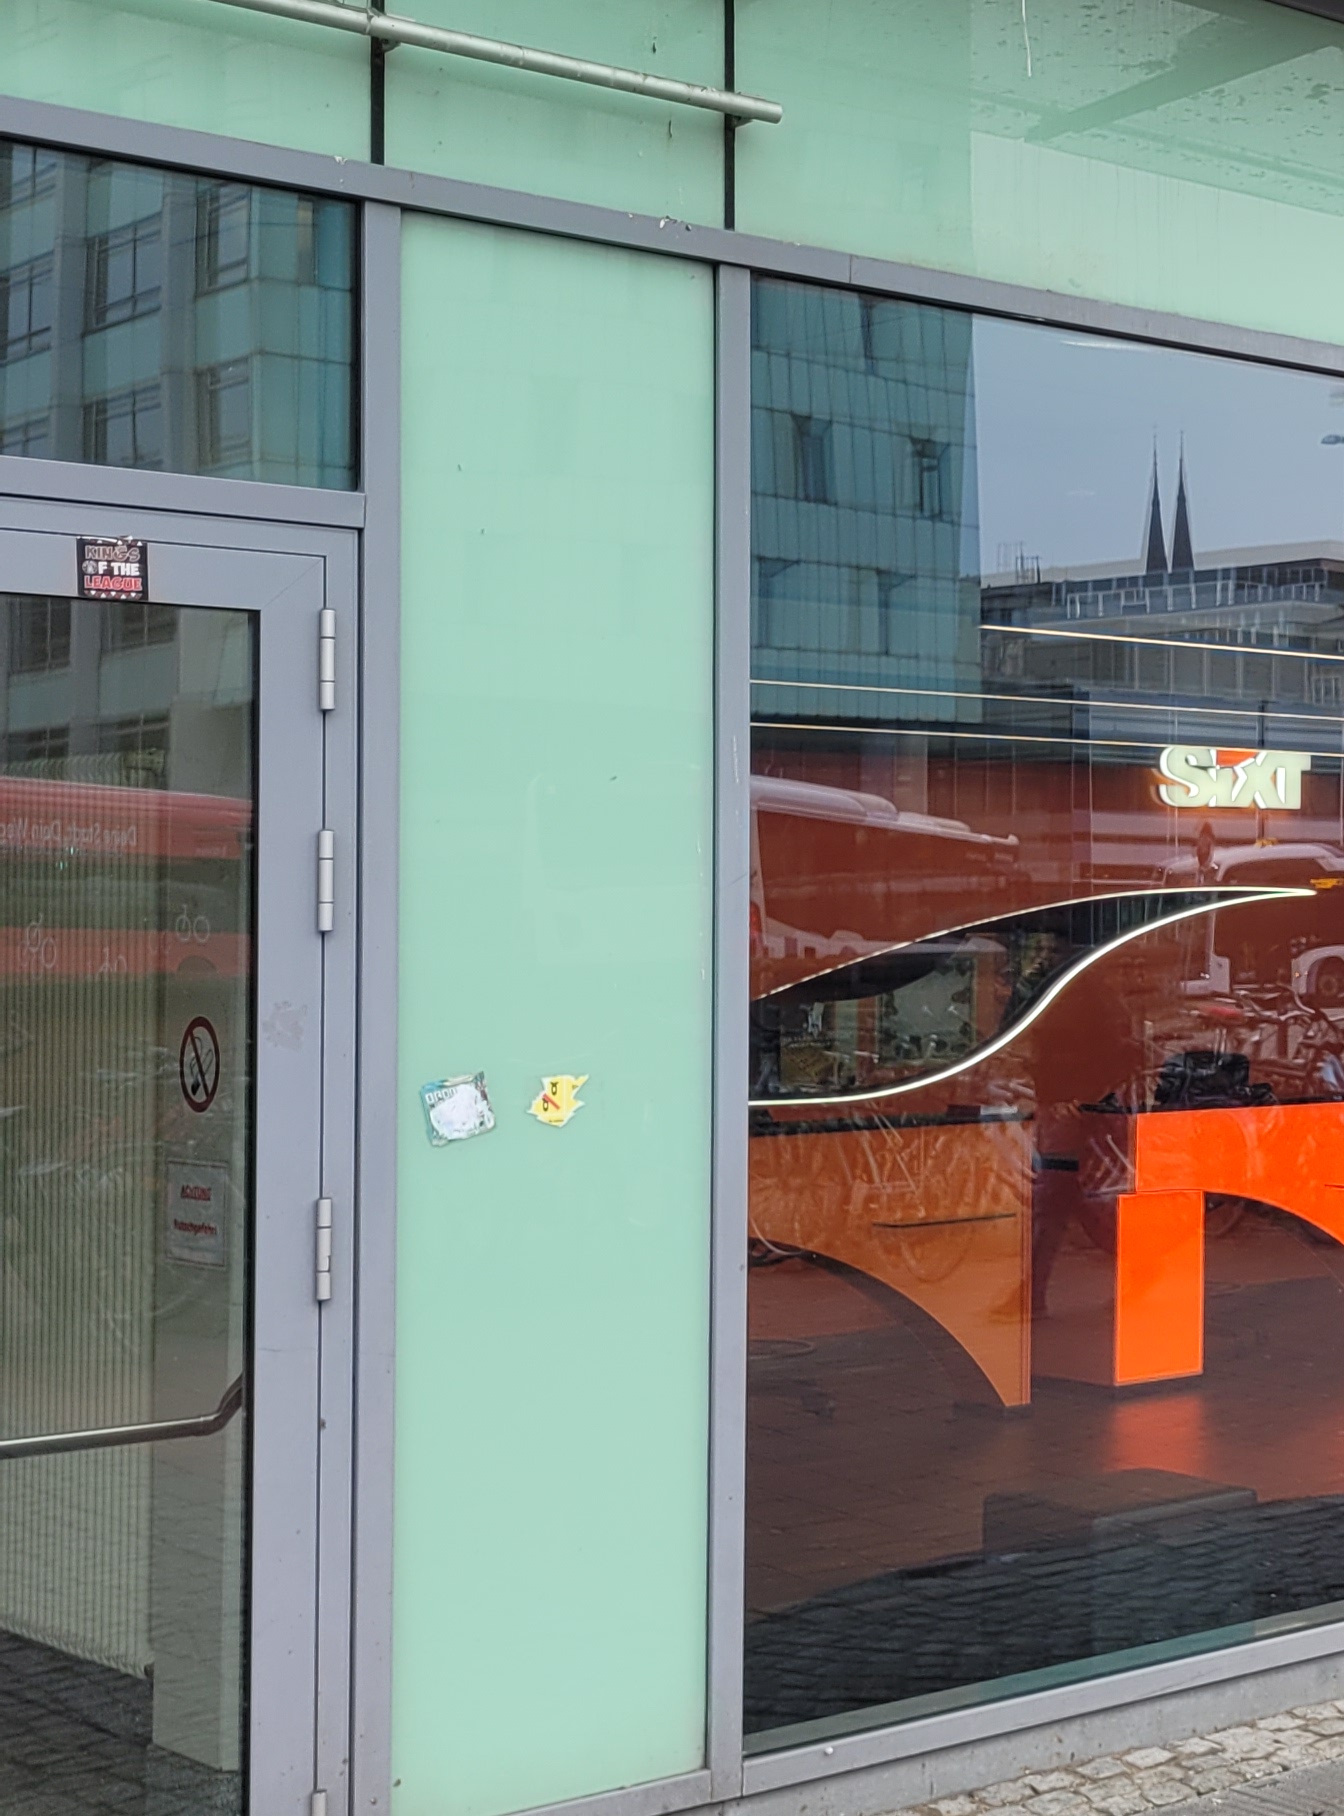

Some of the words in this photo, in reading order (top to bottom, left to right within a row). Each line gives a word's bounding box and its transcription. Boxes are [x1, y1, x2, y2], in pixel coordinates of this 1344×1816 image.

[84, 544, 141, 562] KINGS
[110, 562, 140, 576] THE
[84, 575, 143, 591] LEAGUE
